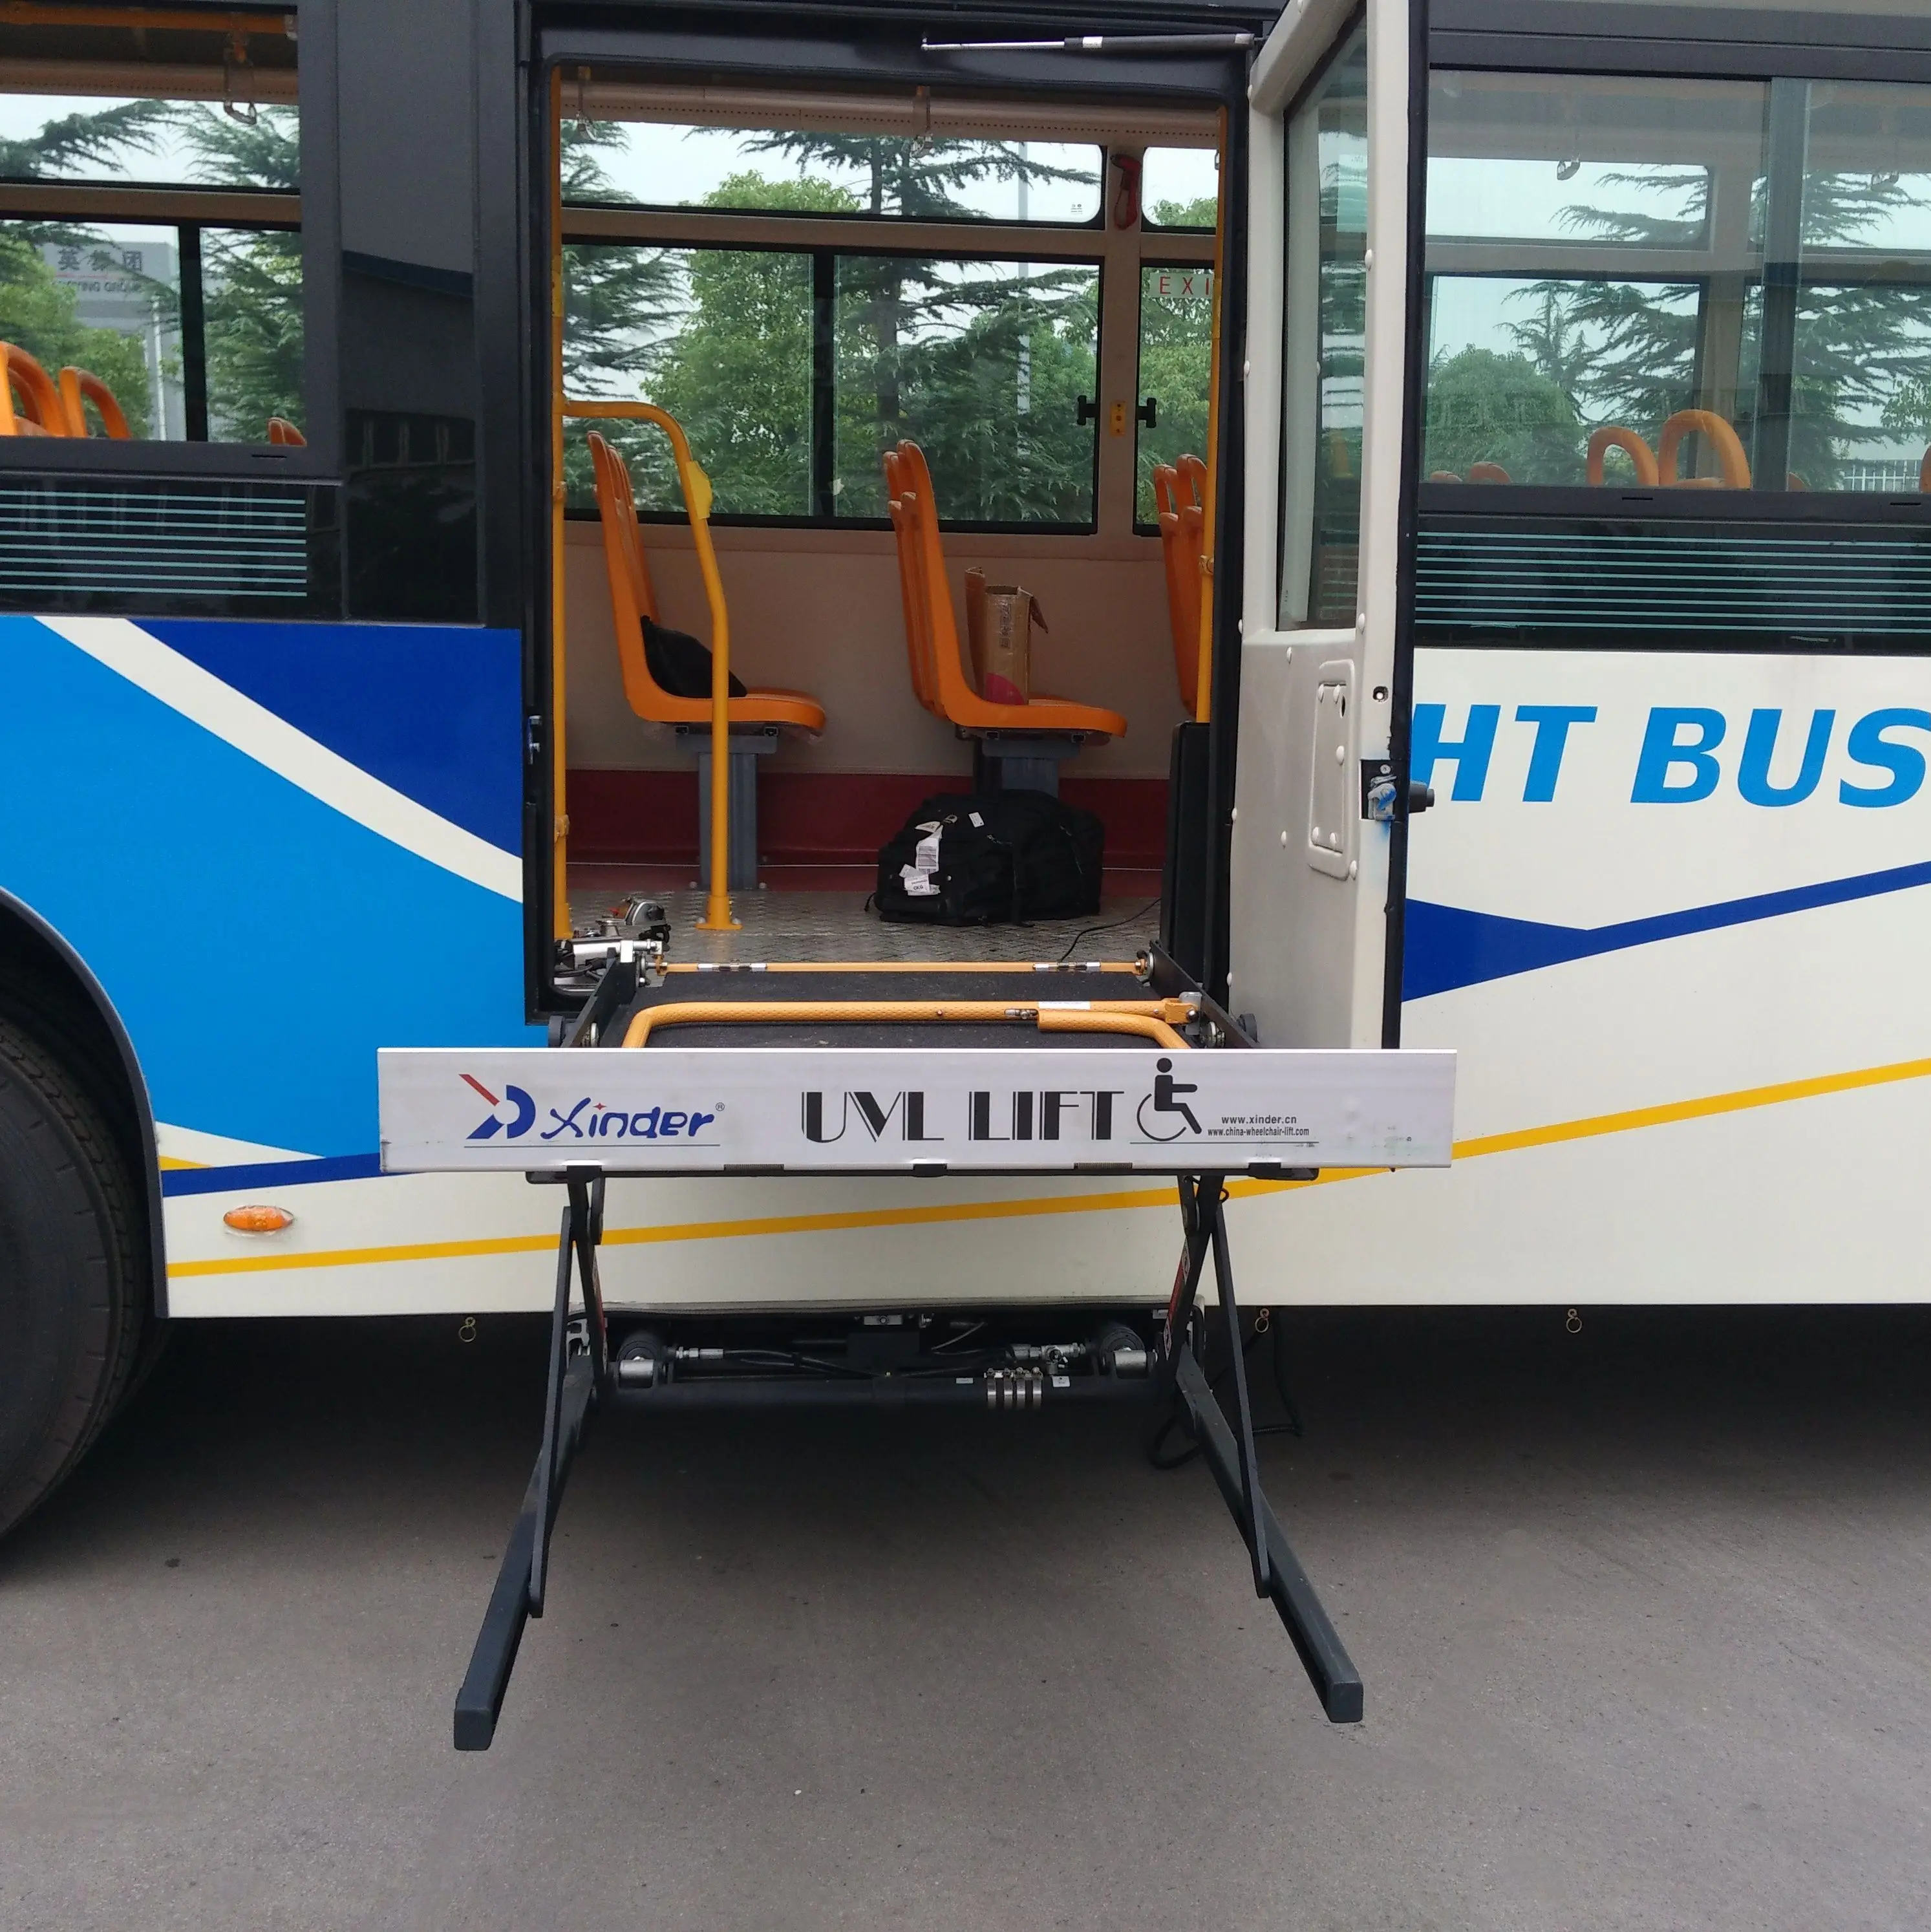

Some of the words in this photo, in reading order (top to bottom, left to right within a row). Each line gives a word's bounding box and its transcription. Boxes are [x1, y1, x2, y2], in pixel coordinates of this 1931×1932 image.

[1630, 707, 1931, 808] BUS
[801, 1091, 944, 1143] UVL
[968, 1091, 1125, 1141] LIFT
[1207, 1127, 1310, 1137] www.china-wheelchair-lift.com
[1221, 1115, 1297, 1124] www.xinder.cn
